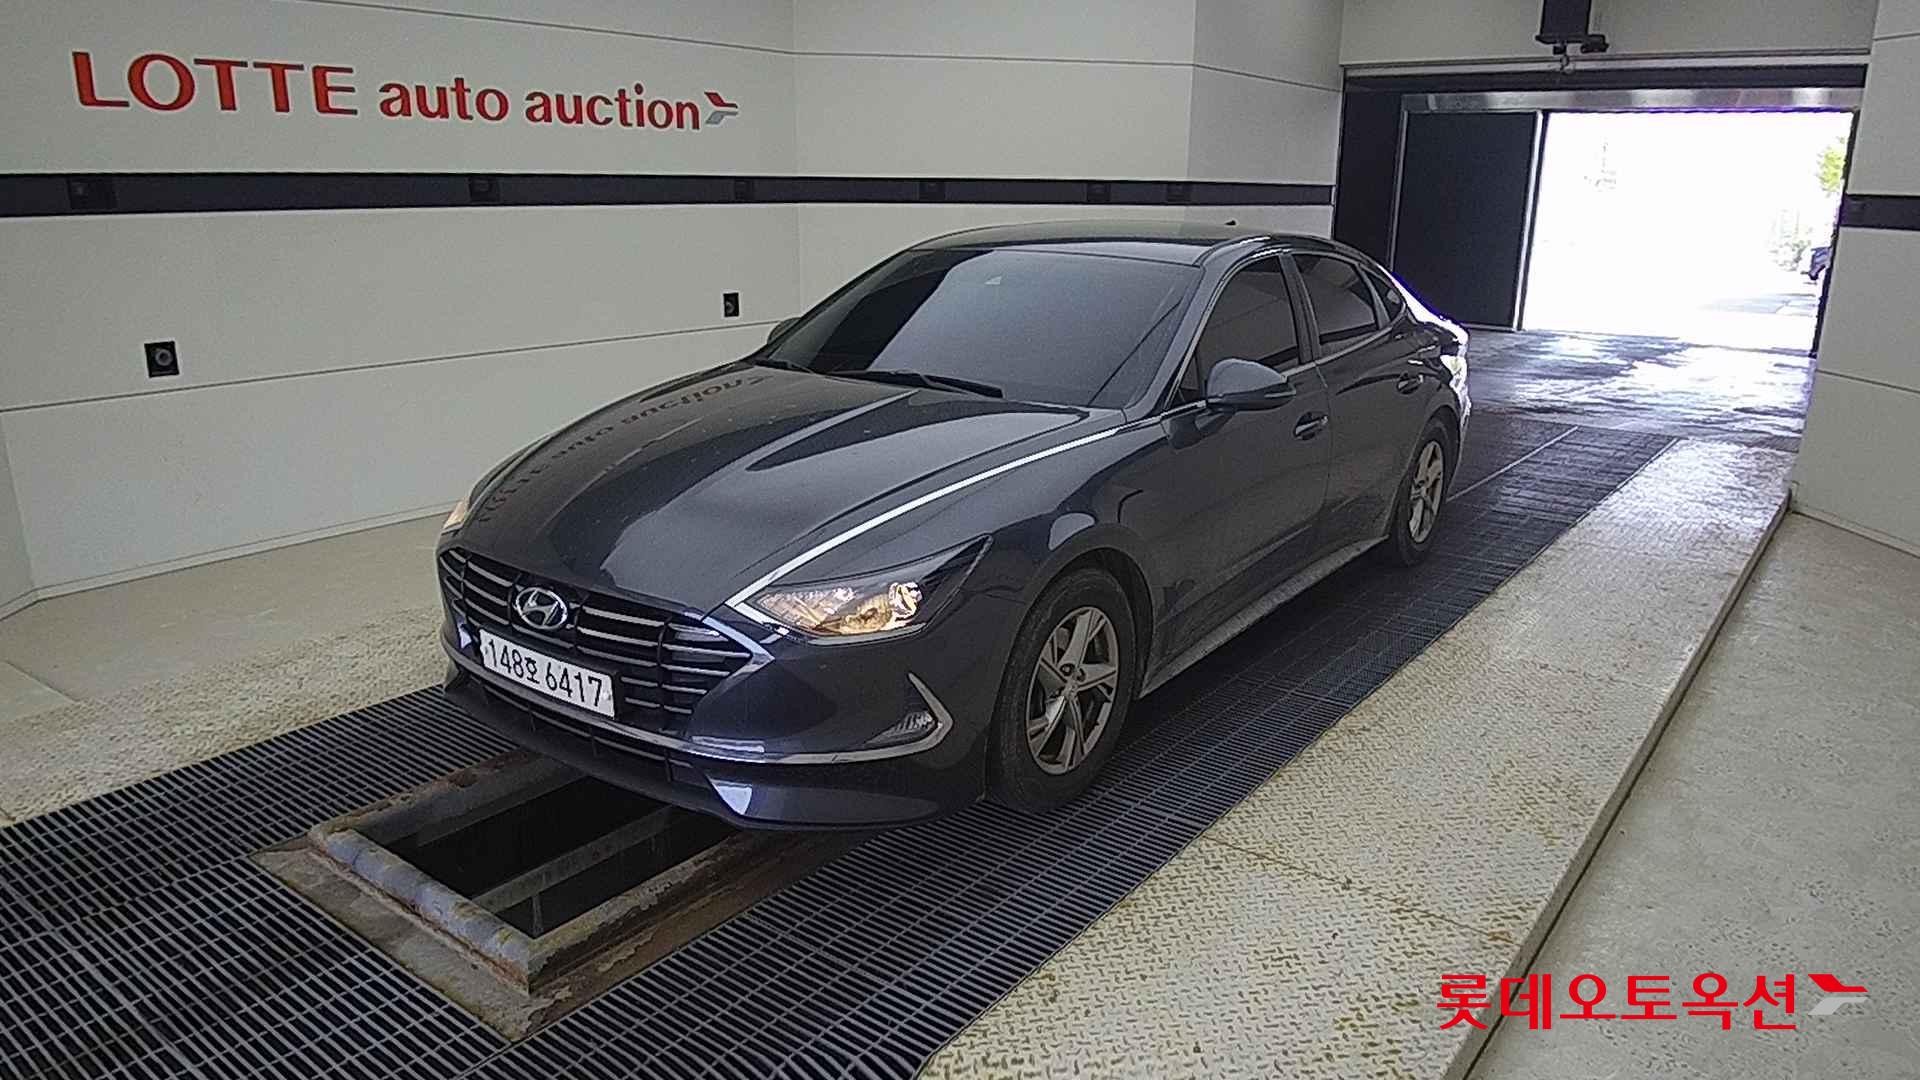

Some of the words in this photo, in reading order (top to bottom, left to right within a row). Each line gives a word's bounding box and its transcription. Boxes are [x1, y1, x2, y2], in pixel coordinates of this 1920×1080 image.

[72, 51, 359, 117] LOTTE
[379, 78, 510, 122] auto
[524, 83, 701, 130] auction
[545, 661, 602, 707] 6417
